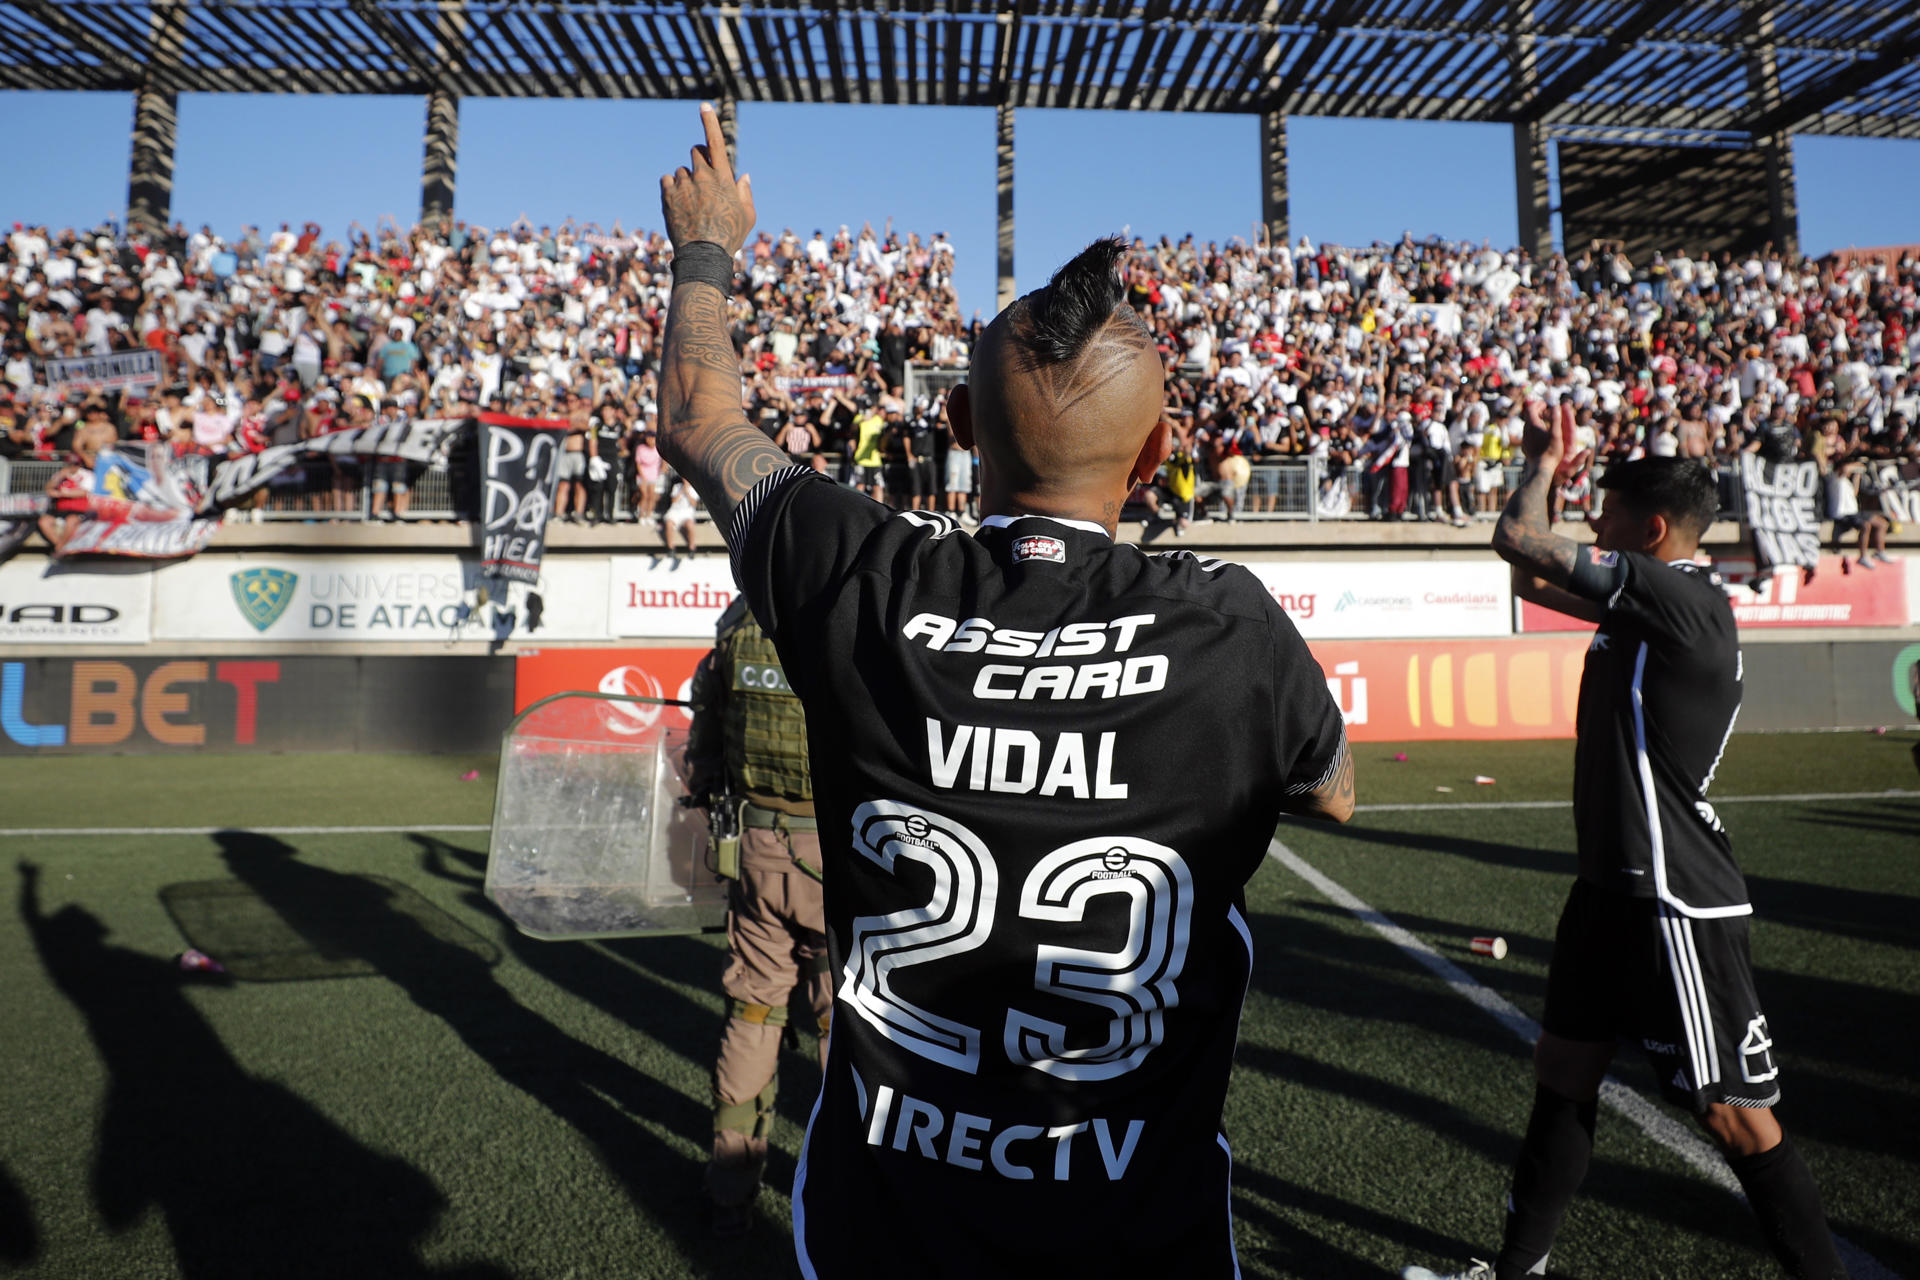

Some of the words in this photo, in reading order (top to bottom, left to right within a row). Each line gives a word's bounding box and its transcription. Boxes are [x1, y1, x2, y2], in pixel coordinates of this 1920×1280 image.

[309, 574, 545, 599] UNIVERS
[628, 582, 732, 609] lundin
[1424, 591, 1497, 605] Candelaria
[0, 604, 119, 622] AD
[310, 604, 355, 628] DE
[903, 613, 1156, 658] ASSIST
[973, 654, 1169, 700] CARD
[926, 717, 1129, 800] VIDAL
[837, 799, 1194, 1082] 23
